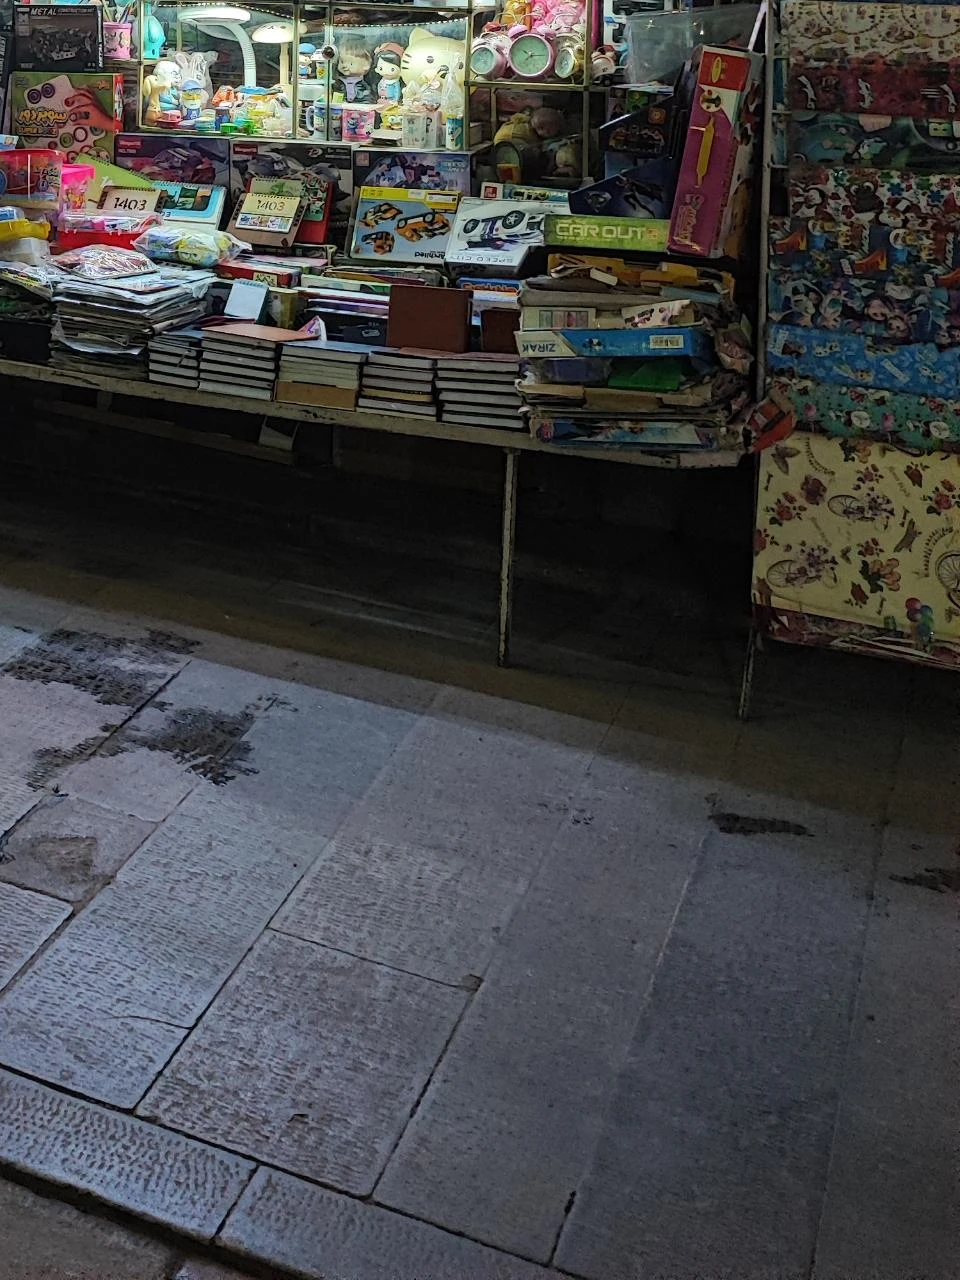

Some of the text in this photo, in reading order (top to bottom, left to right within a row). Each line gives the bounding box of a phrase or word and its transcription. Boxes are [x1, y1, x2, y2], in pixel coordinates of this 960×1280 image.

[30, 7, 58, 16] METAL
[113, 196, 148, 212] 1403
[255, 199, 286, 212] 1403
[555, 223, 600, 239] CAR
[601, 224, 647, 241] OUT
[521, 342, 557, 354] ZIRAK
